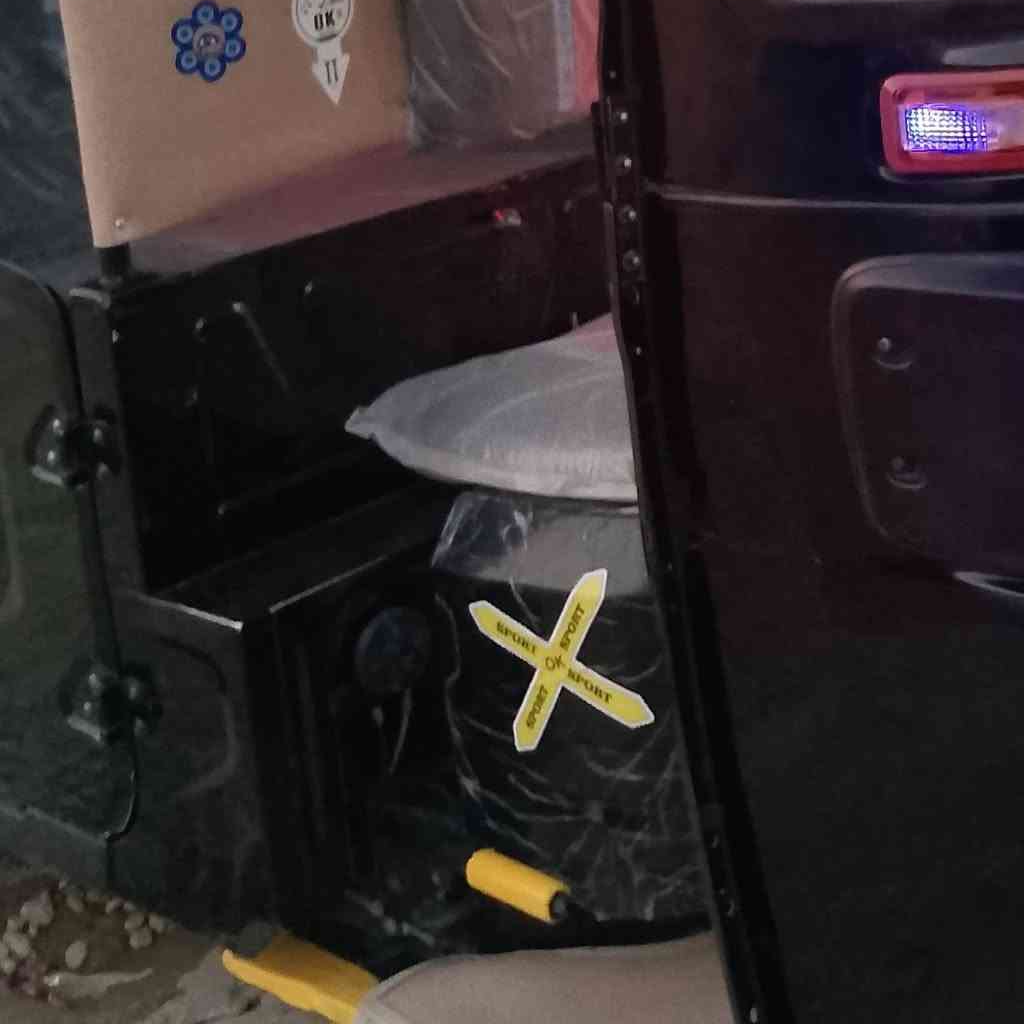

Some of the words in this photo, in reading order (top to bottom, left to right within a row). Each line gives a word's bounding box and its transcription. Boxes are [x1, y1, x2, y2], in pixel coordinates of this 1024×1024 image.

[497, 621, 537, 655] SPORT
[559, 604, 586, 651] SPORT
[544, 655, 564, 671] OK
[567, 669, 613, 704] SPORT
[525, 686, 549, 729] SPORT
